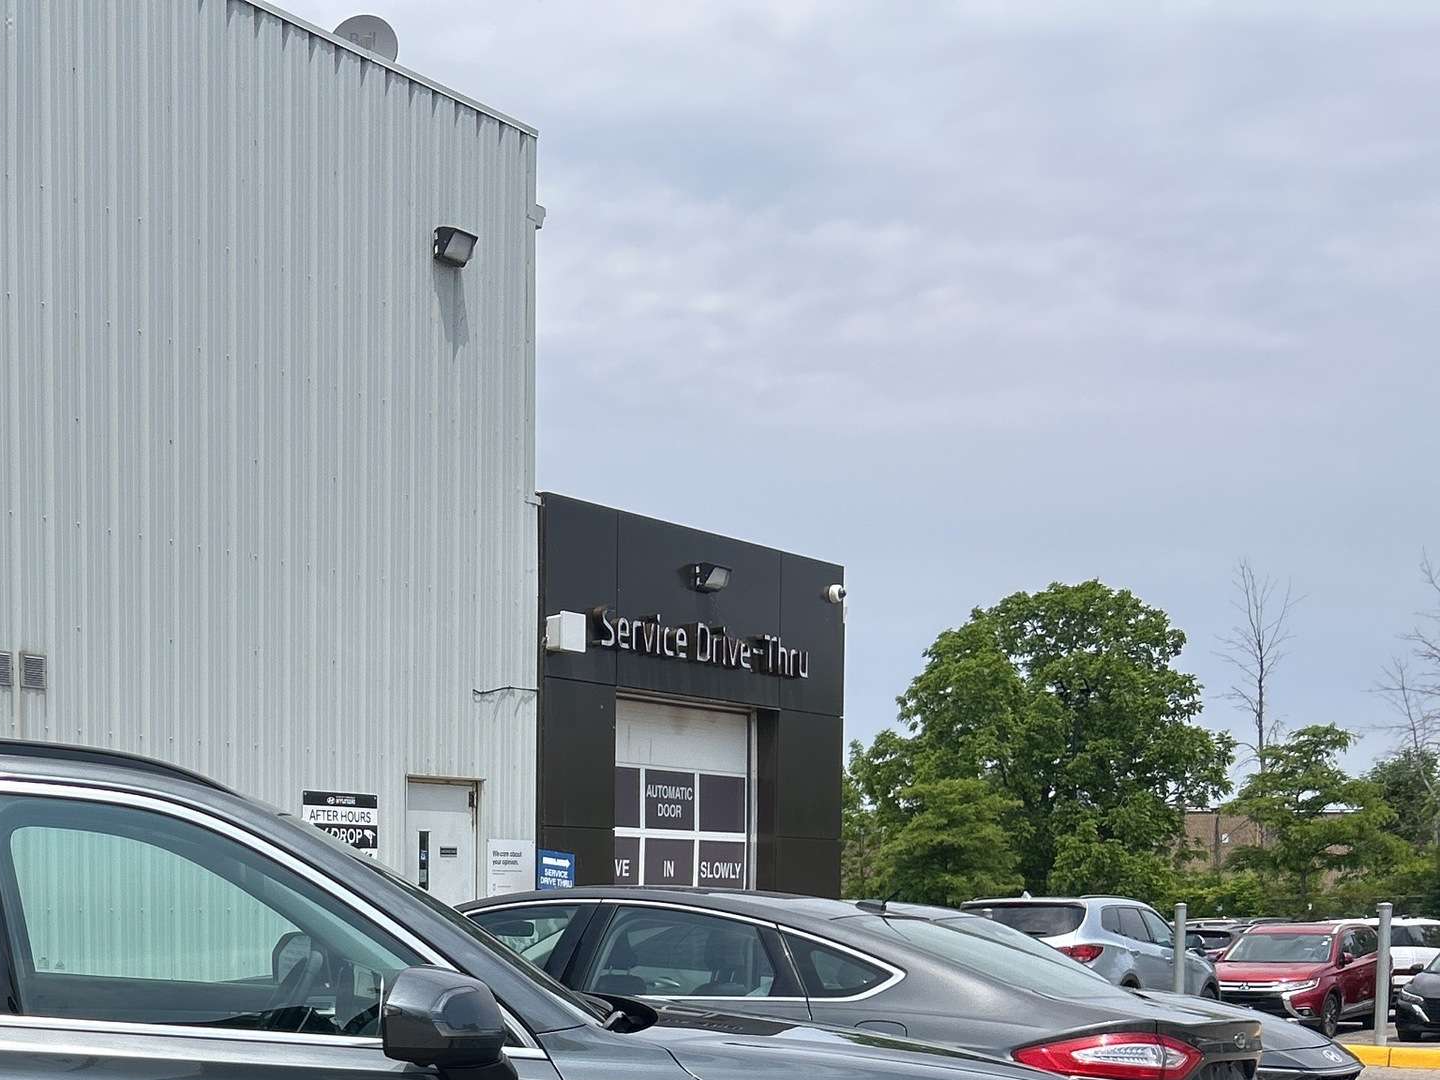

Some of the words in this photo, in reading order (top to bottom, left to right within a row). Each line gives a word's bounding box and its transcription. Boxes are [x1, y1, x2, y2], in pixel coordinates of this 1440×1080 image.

[601, 610, 688, 659] Service
[696, 622, 809, 679] Drive-Thru
[646, 784, 693, 800] AUTOMATIC
[309, 809, 338, 821] AFTER
[341, 810, 371, 823] HOURS
[657, 803, 682, 818] DOOR
[331, 827, 362, 844] DROP
[544, 868, 569, 879] SERVICE
[614, 859, 630, 877] VE
[663, 860, 674, 877] IN
[700, 861, 741, 879] SLOWLY
[540, 876, 557, 886] DRIVE
